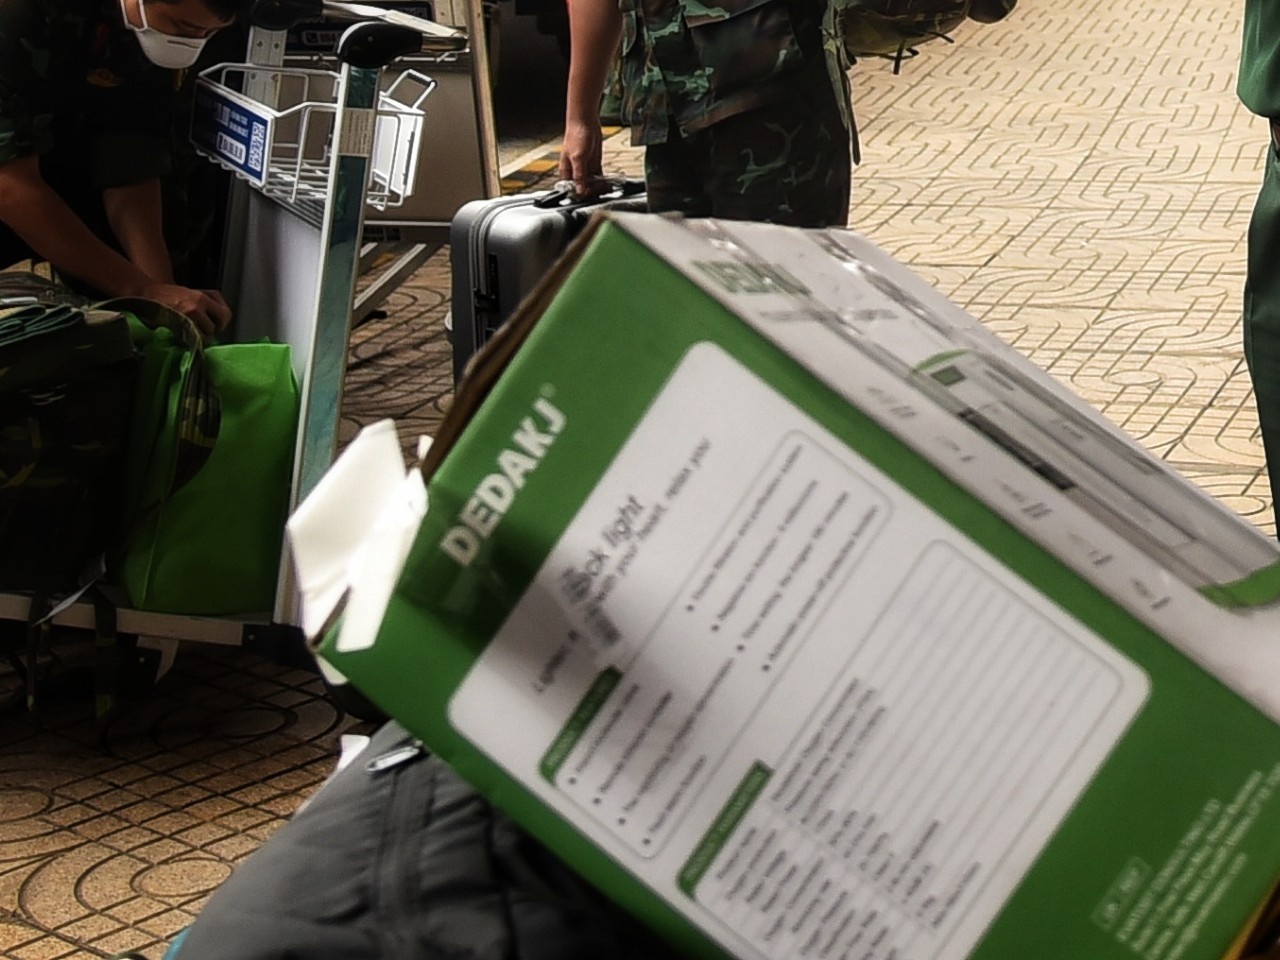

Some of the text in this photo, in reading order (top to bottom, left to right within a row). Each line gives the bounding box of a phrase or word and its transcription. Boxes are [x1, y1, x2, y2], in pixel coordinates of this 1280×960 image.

[439, 396, 567, 567] DEDAKJ
[664, 466, 692, 500] relax
[688, 438, 711, 468] you
[602, 495, 644, 548] light
